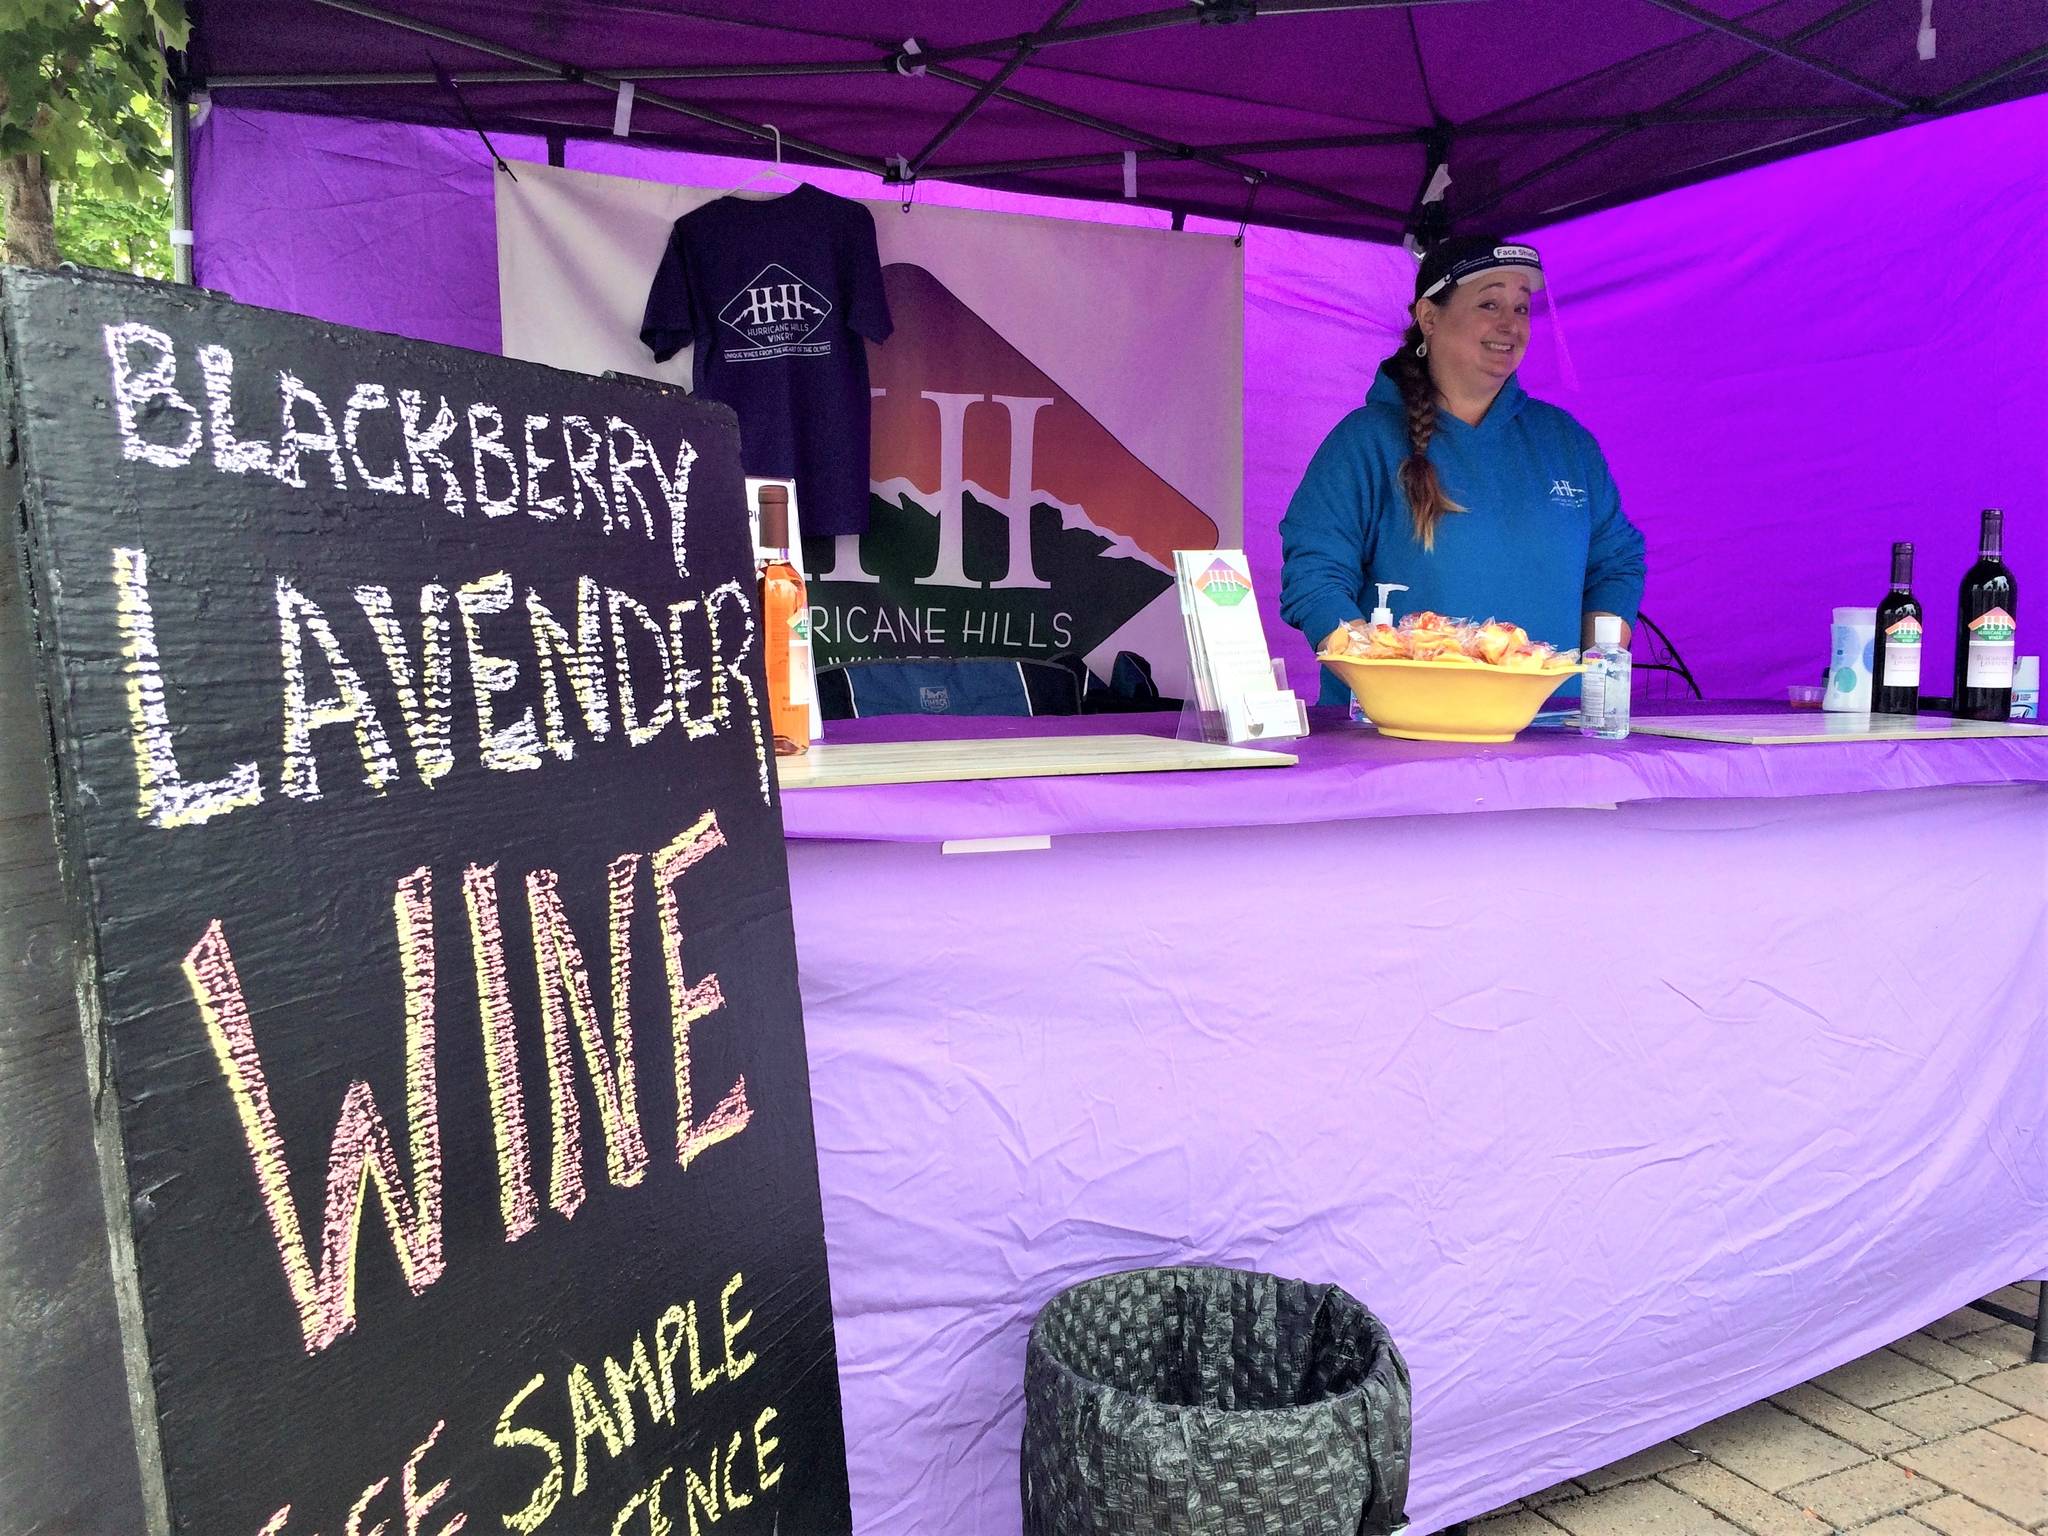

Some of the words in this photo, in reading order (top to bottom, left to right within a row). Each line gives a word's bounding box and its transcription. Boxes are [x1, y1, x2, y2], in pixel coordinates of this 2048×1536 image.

[1496, 248, 1517, 257] Face
[747, 323, 790, 337] HURRICANE
[790, 322, 809, 333] HILLS
[767, 332, 794, 343] WINERY
[724, 352, 743, 360] UNIQUE
[759, 349, 773, 357] FROM
[103, 321, 698, 578] BLACKBERRY
[808, 605, 947, 645] RICANE
[962, 609, 1073, 649] HILLS
[111, 547, 772, 829] LAVENDER
[182, 809, 755, 1355] WINE
[257, 1419, 468, 1536] EE
[493, 1271, 757, 1535] SAMPLE
